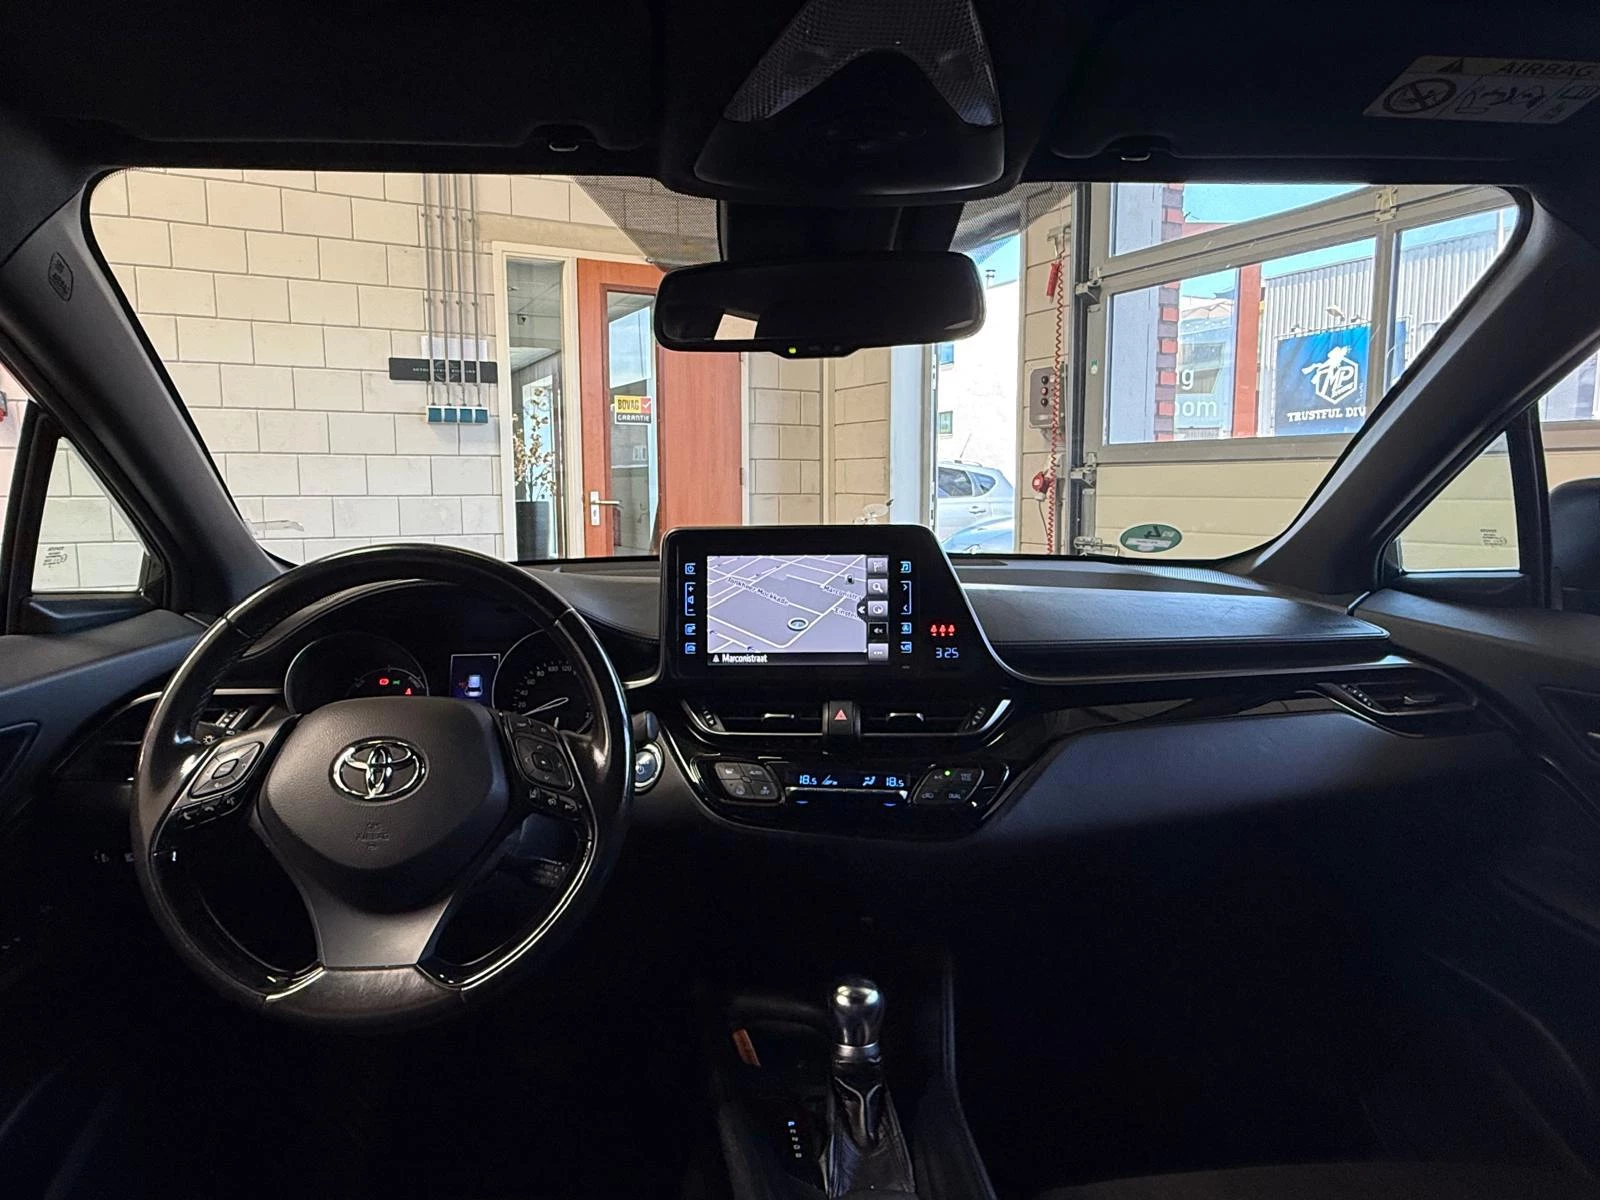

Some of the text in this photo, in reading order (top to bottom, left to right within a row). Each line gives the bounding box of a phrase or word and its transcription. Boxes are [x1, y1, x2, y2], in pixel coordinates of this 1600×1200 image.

[1495, 62, 1598, 76] AIRBAG
[618, 399, 640, 410] BOVAG
[617, 414, 650, 422] GARANTIE
[1287, 408, 1343, 422] TRUSTFUL
[722, 653, 768, 663] Marconistraat
[799, 775, 817, 785] 18.5
[886, 777, 904, 787] 18.5
